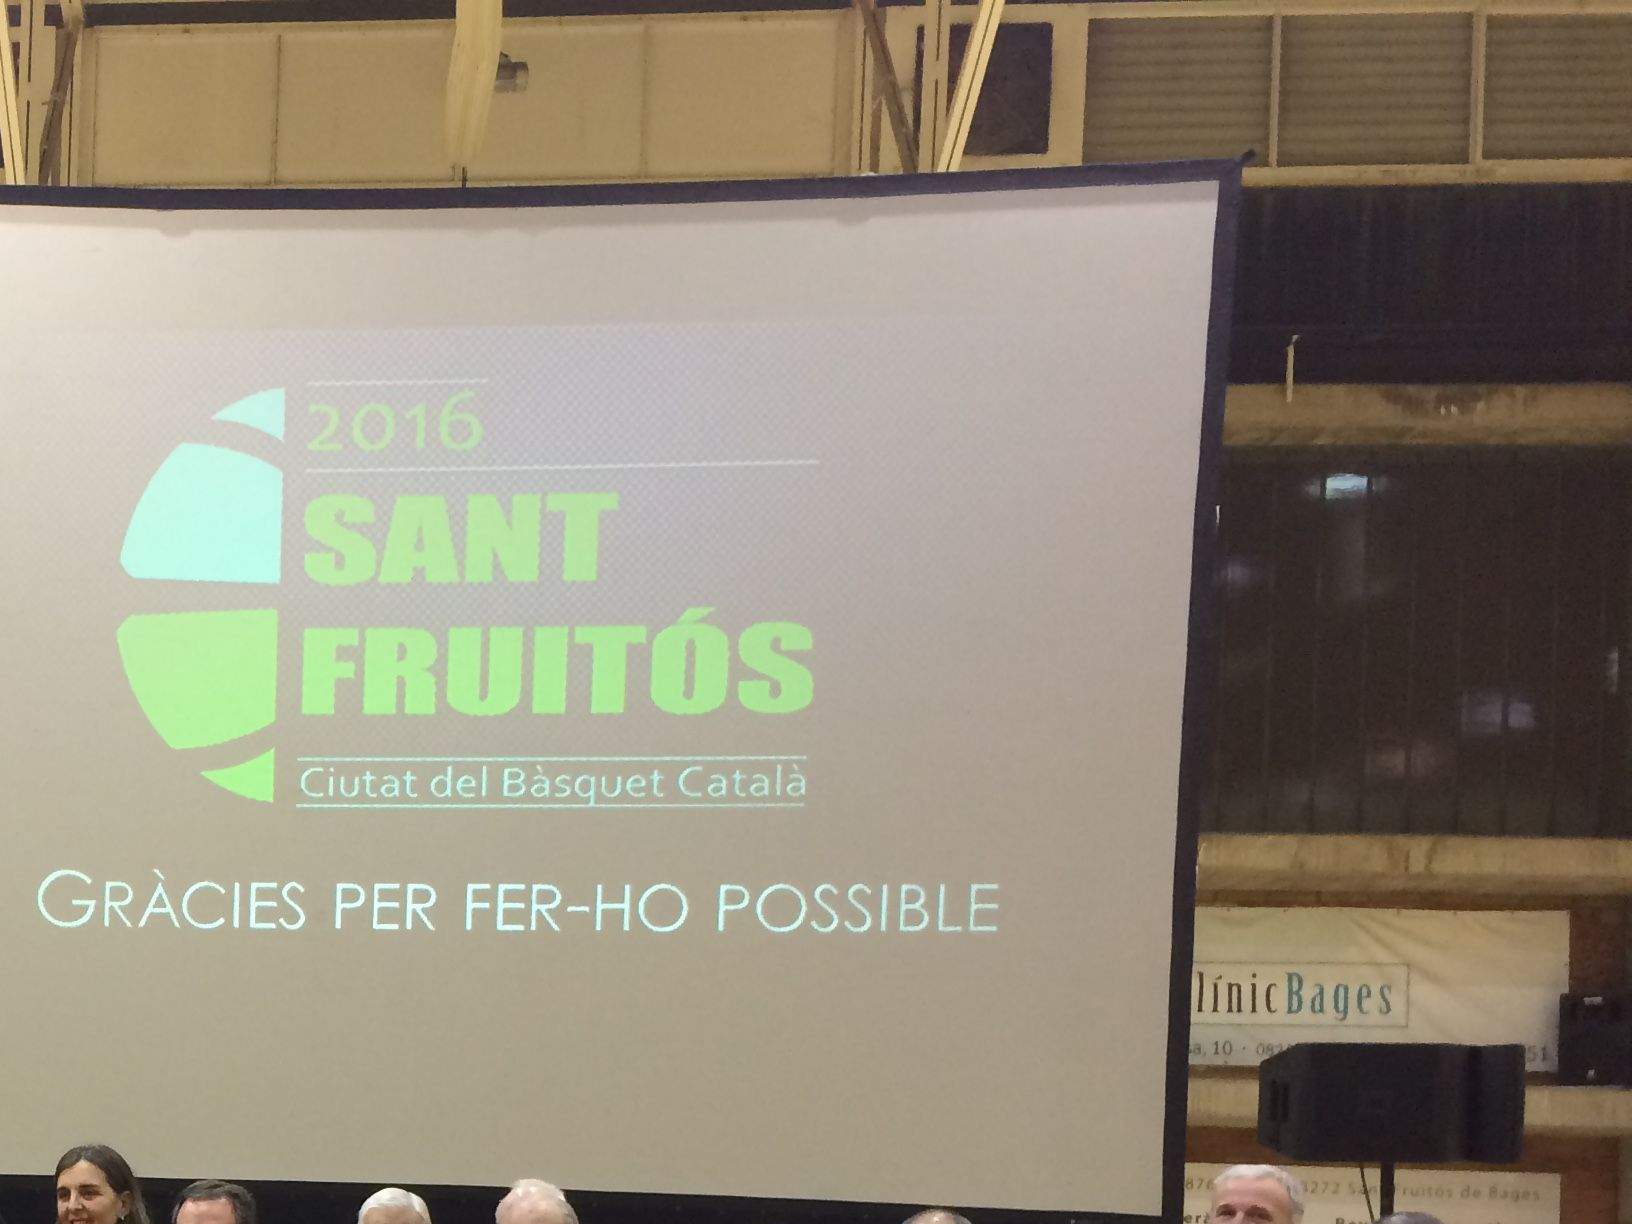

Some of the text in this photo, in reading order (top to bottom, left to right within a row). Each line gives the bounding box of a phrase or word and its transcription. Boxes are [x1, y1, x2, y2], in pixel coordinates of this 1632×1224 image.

[306, 390, 485, 455] 2016
[303, 491, 620, 586] SANT
[300, 606, 815, 716] FRUITÓS
[299, 764, 808, 805] Ciutat del Bàsquet Català
[335, 882, 438, 931] PER
[465, 882, 689, 933] FER-HO
[717, 882, 1000, 934] POSSIBLE
[1213, 1040, 1232, 1056] 10
[1460, 1184, 1482, 1200] de
[1489, 1185, 1541, 1203] Bages
